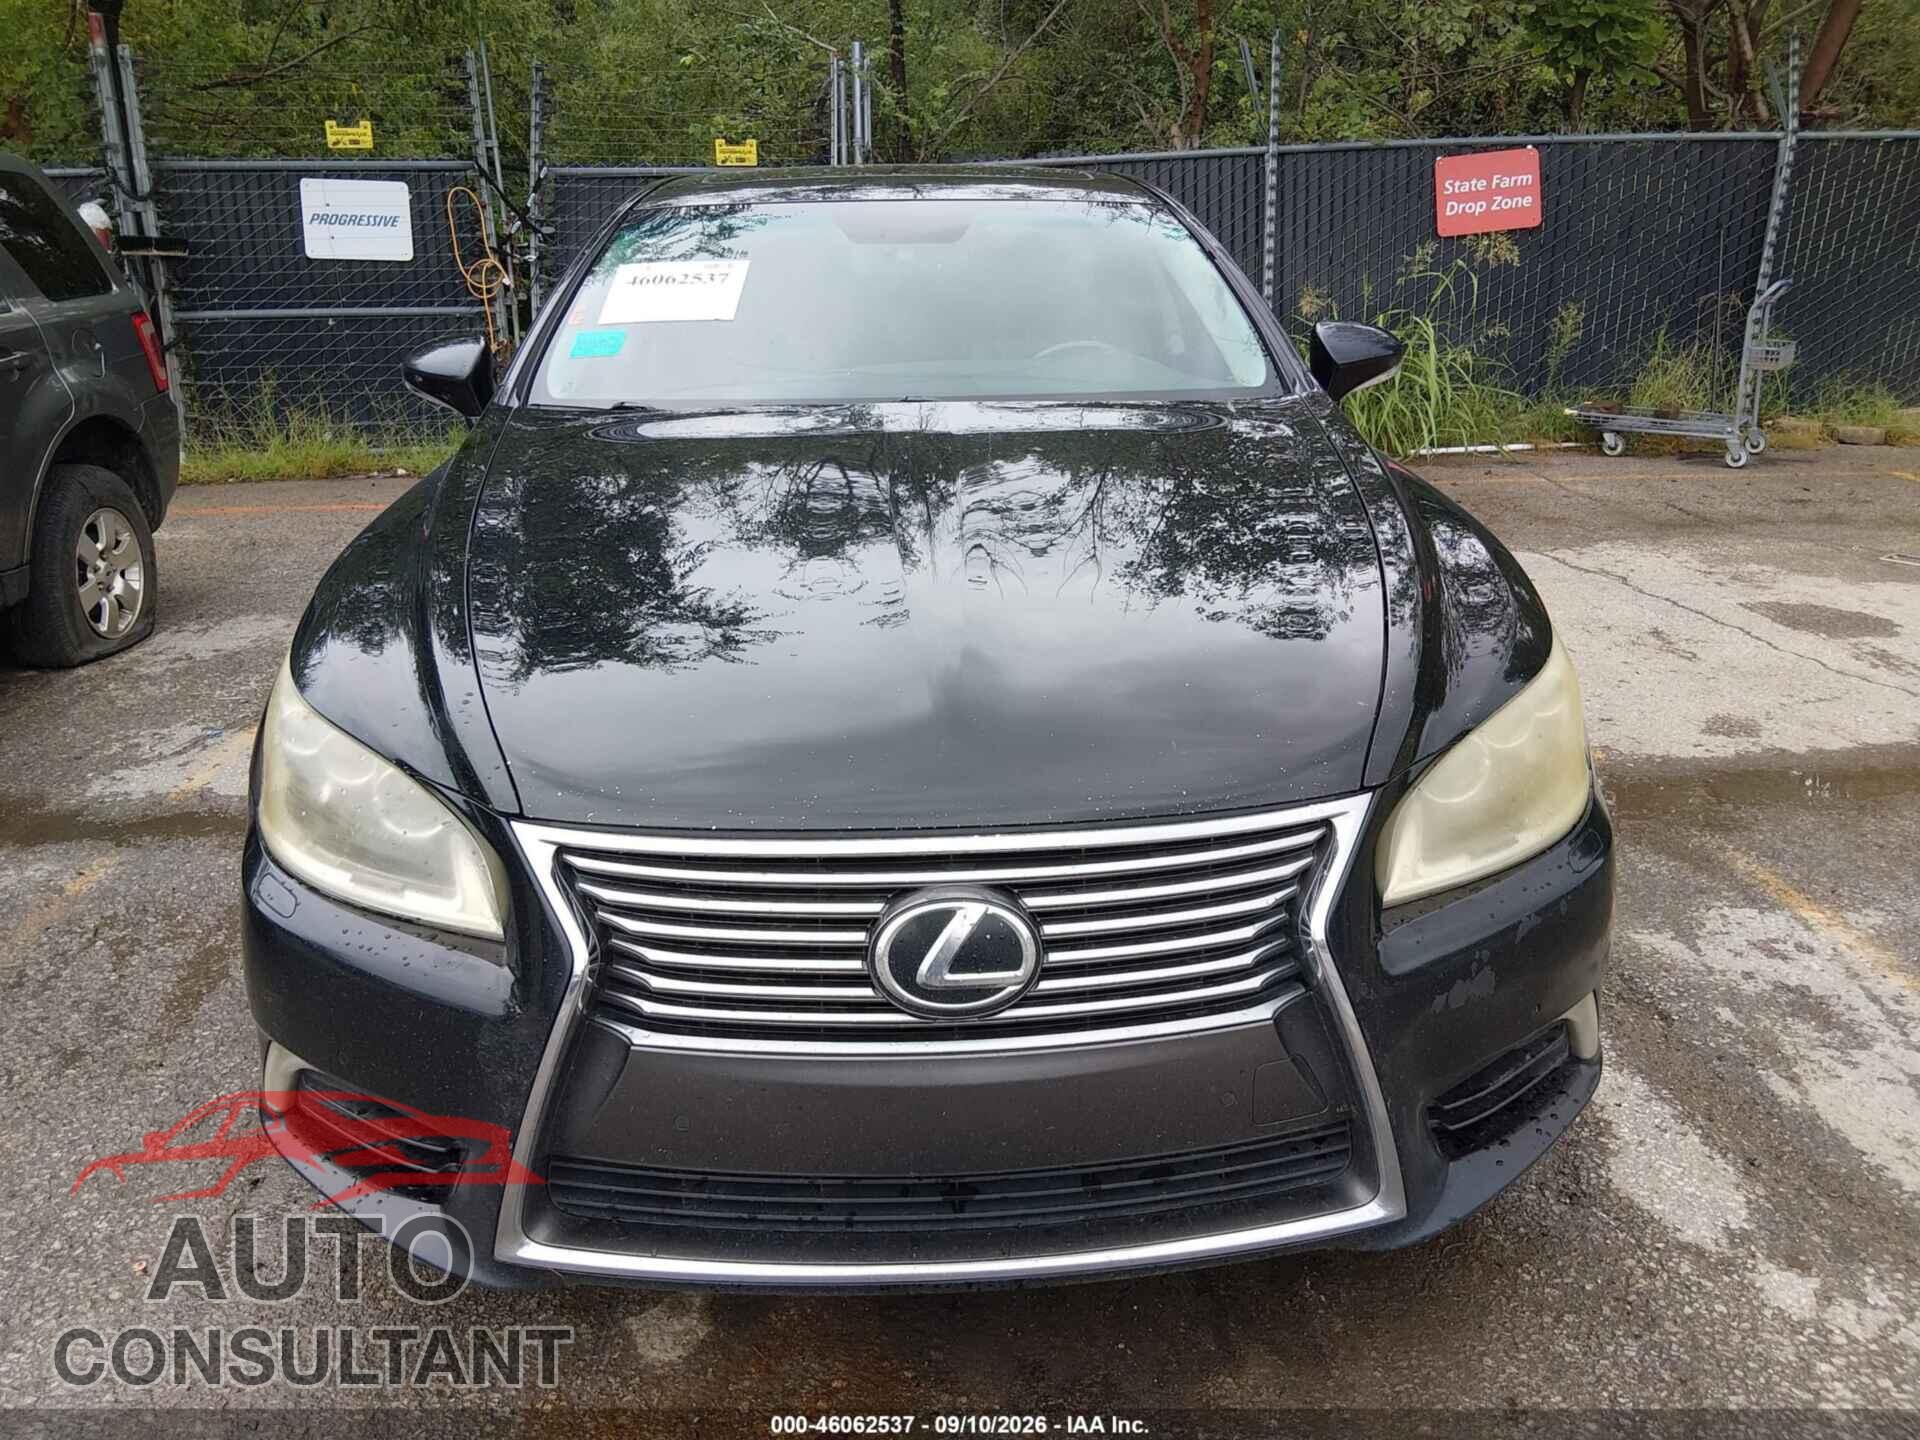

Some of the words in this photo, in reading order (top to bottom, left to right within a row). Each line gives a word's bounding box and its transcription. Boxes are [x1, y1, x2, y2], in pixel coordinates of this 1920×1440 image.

[1443, 178, 1487, 194] State
[1492, 174, 1533, 189] Farm
[1445, 201, 1487, 217] Drop
[1491, 195, 1533, 211] Zone
[309, 213, 401, 228] PROGRESSIVE
[626, 272, 730, 286] 46062537
